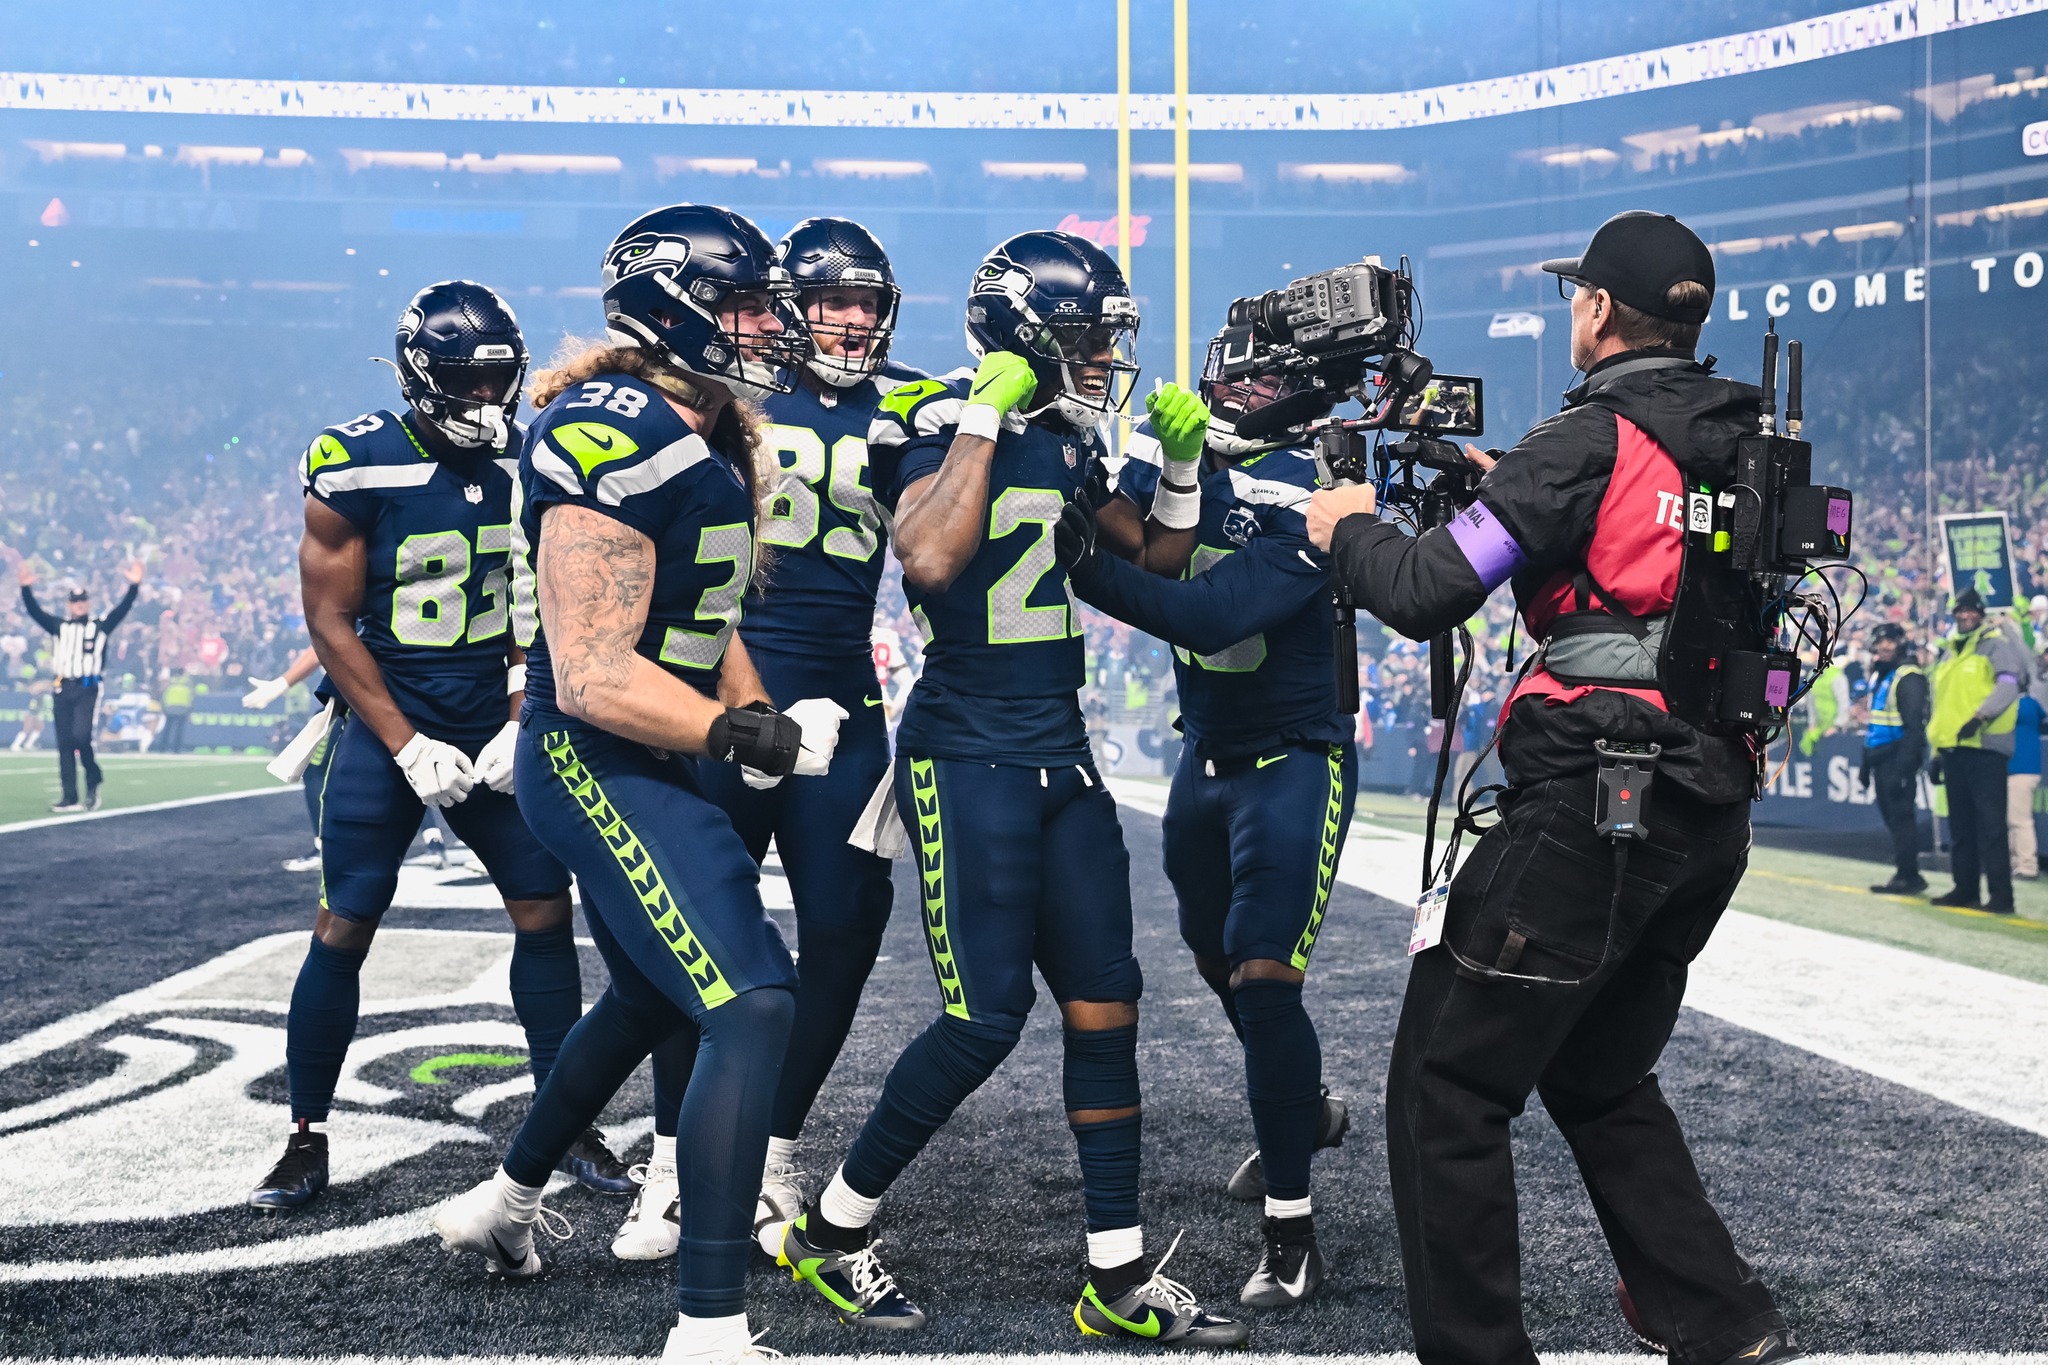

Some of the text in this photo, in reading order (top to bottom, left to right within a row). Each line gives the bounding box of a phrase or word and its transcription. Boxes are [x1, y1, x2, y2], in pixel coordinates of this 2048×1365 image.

[1703, 251, 2044, 323] LCOME TO
[566, 382, 649, 418] 38
